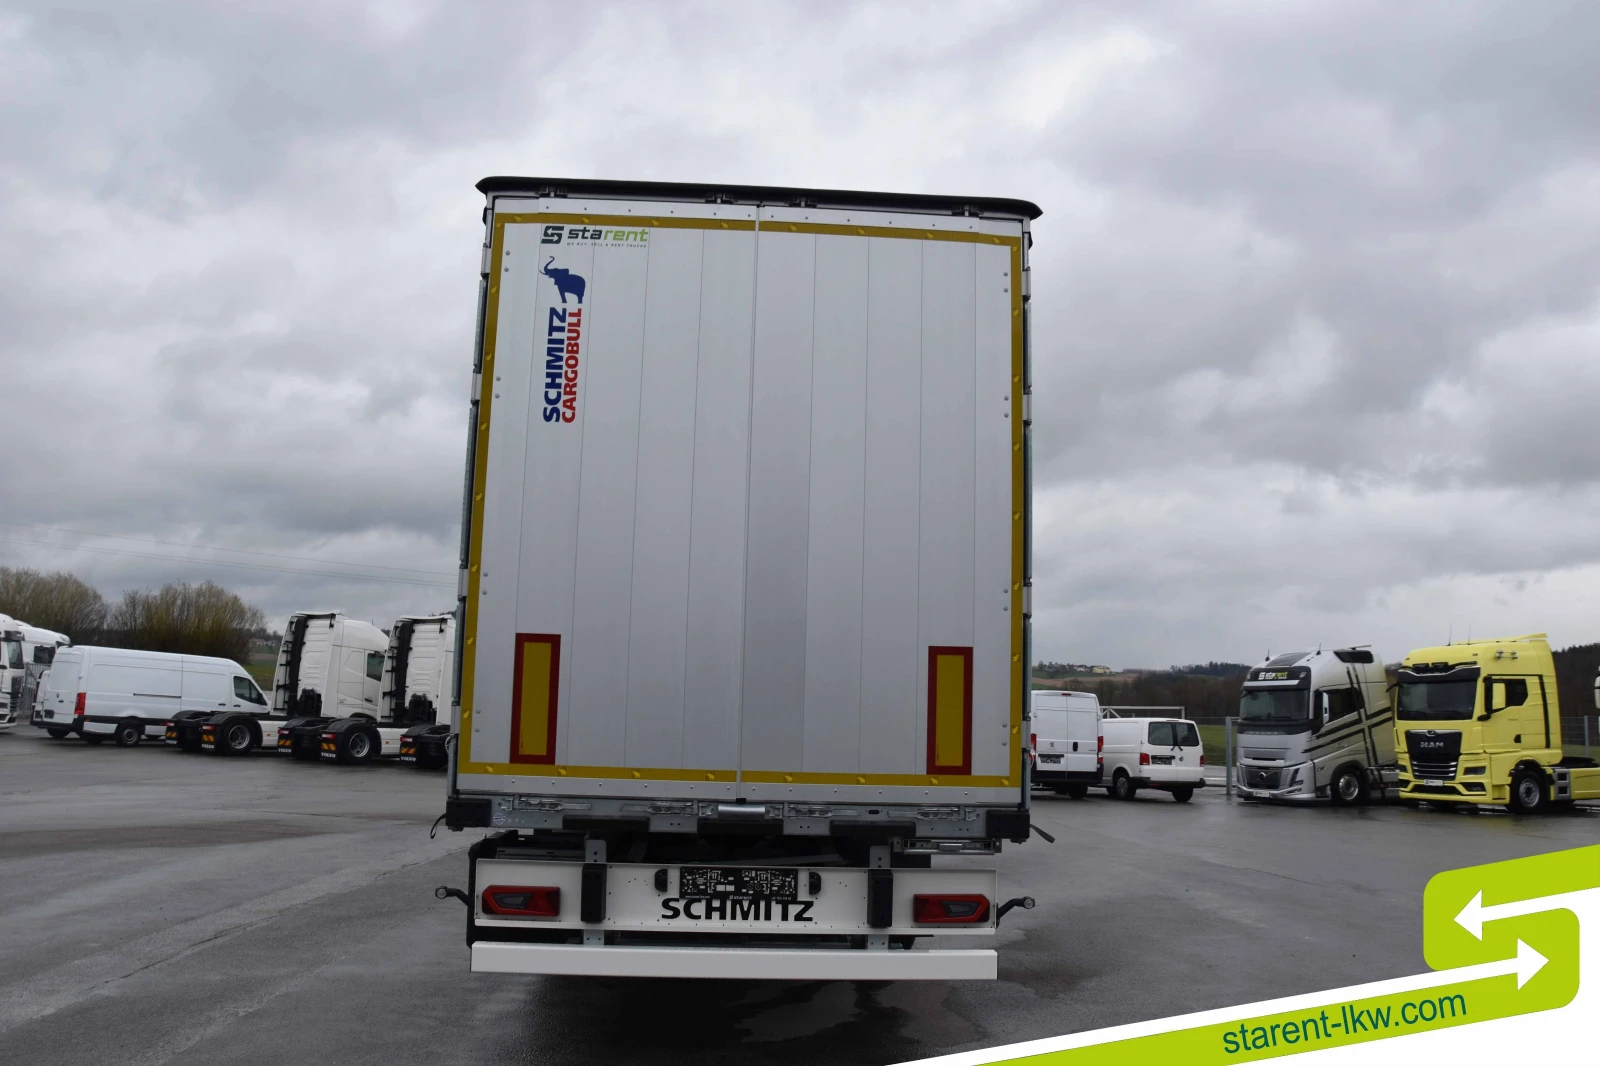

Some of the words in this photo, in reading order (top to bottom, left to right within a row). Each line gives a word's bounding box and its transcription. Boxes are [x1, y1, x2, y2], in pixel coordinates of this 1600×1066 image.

[568, 227, 649, 242] starent
[543, 307, 567, 422] SCHMITZ
[562, 308, 582, 423] CARGOBULL
[661, 897, 814, 921] SCHMITZ
